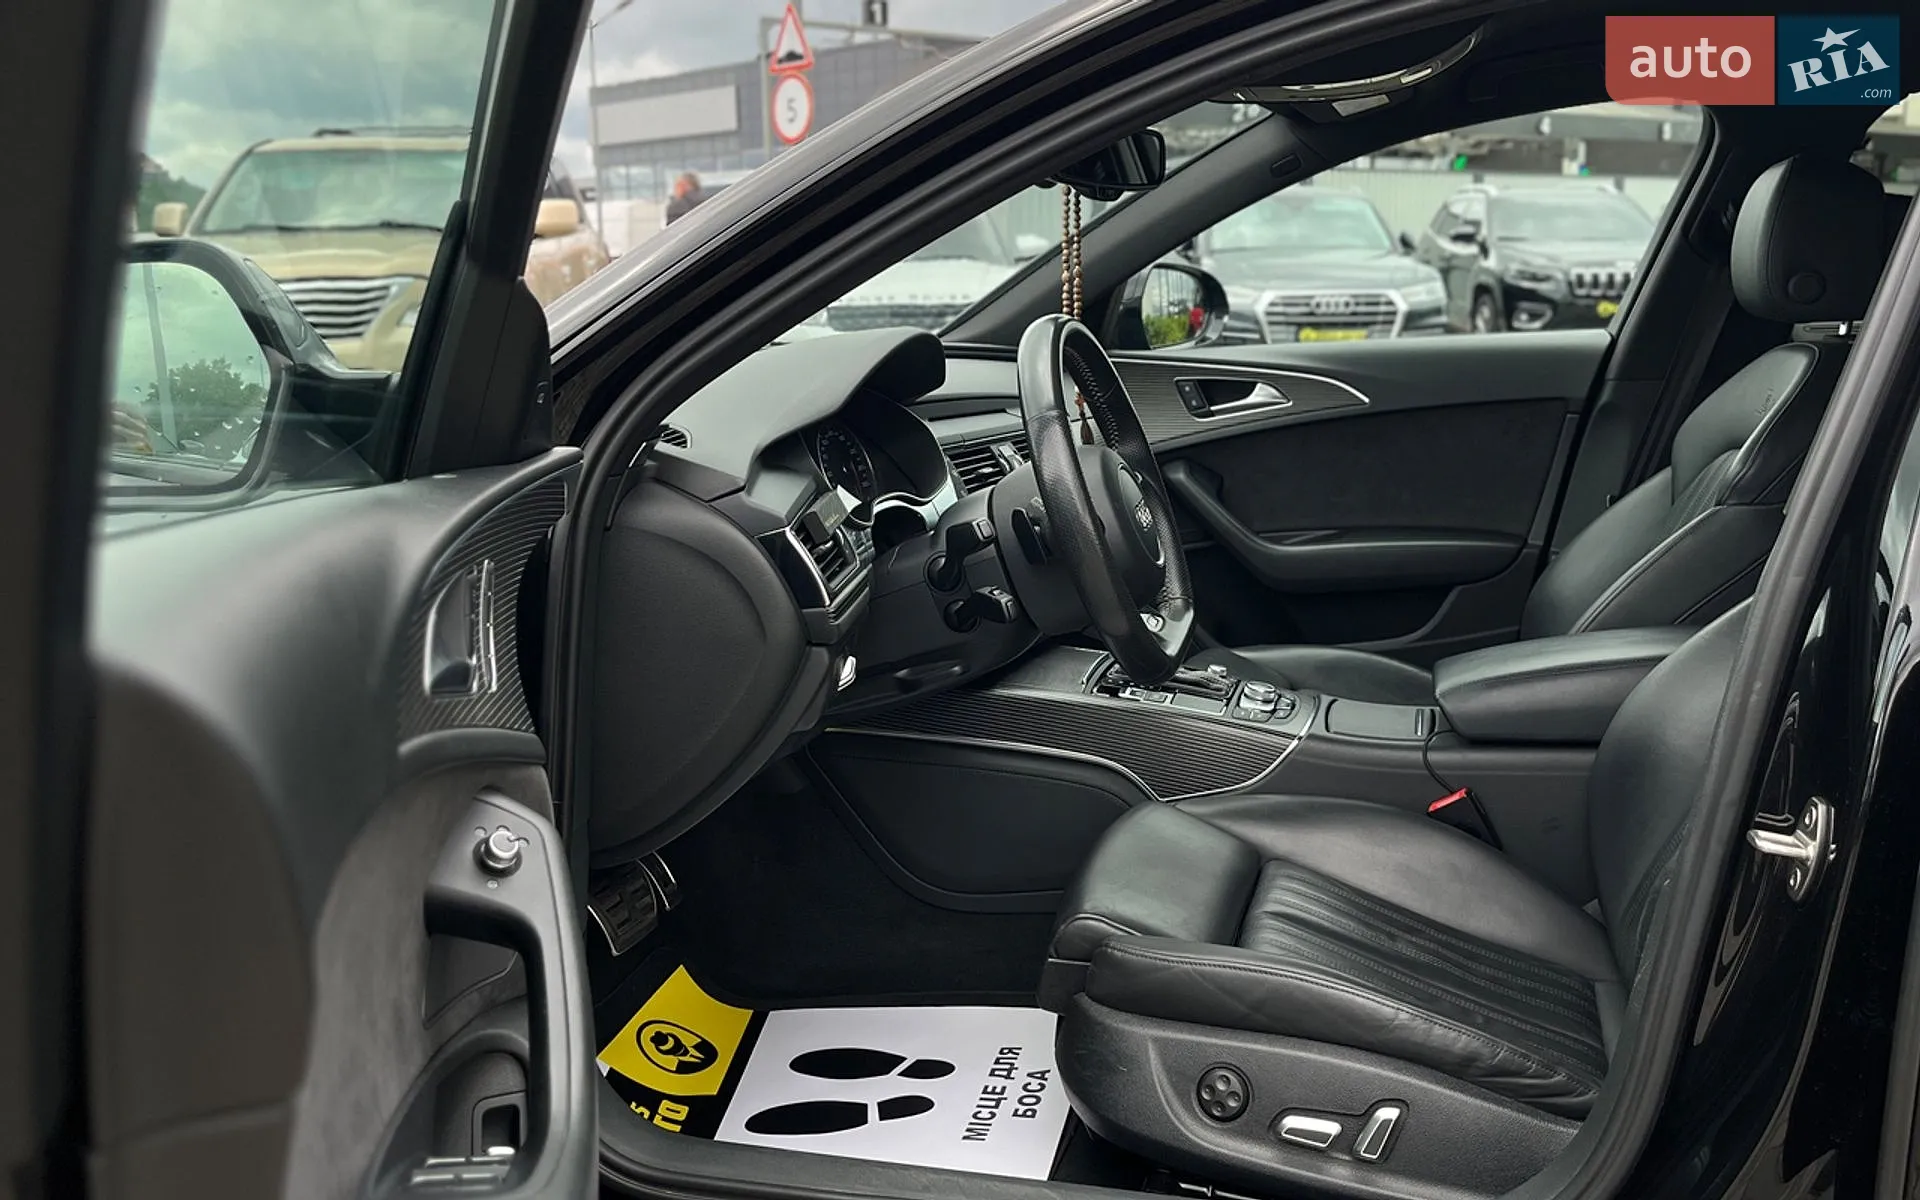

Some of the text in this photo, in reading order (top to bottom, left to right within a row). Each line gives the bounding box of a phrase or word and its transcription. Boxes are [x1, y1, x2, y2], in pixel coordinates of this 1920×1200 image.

[786, 97, 798, 124] 5
[961, 1046, 1023, 1142] МІСЦЕ ДЛЯ
[1011, 1069, 1052, 1119] БОСА
